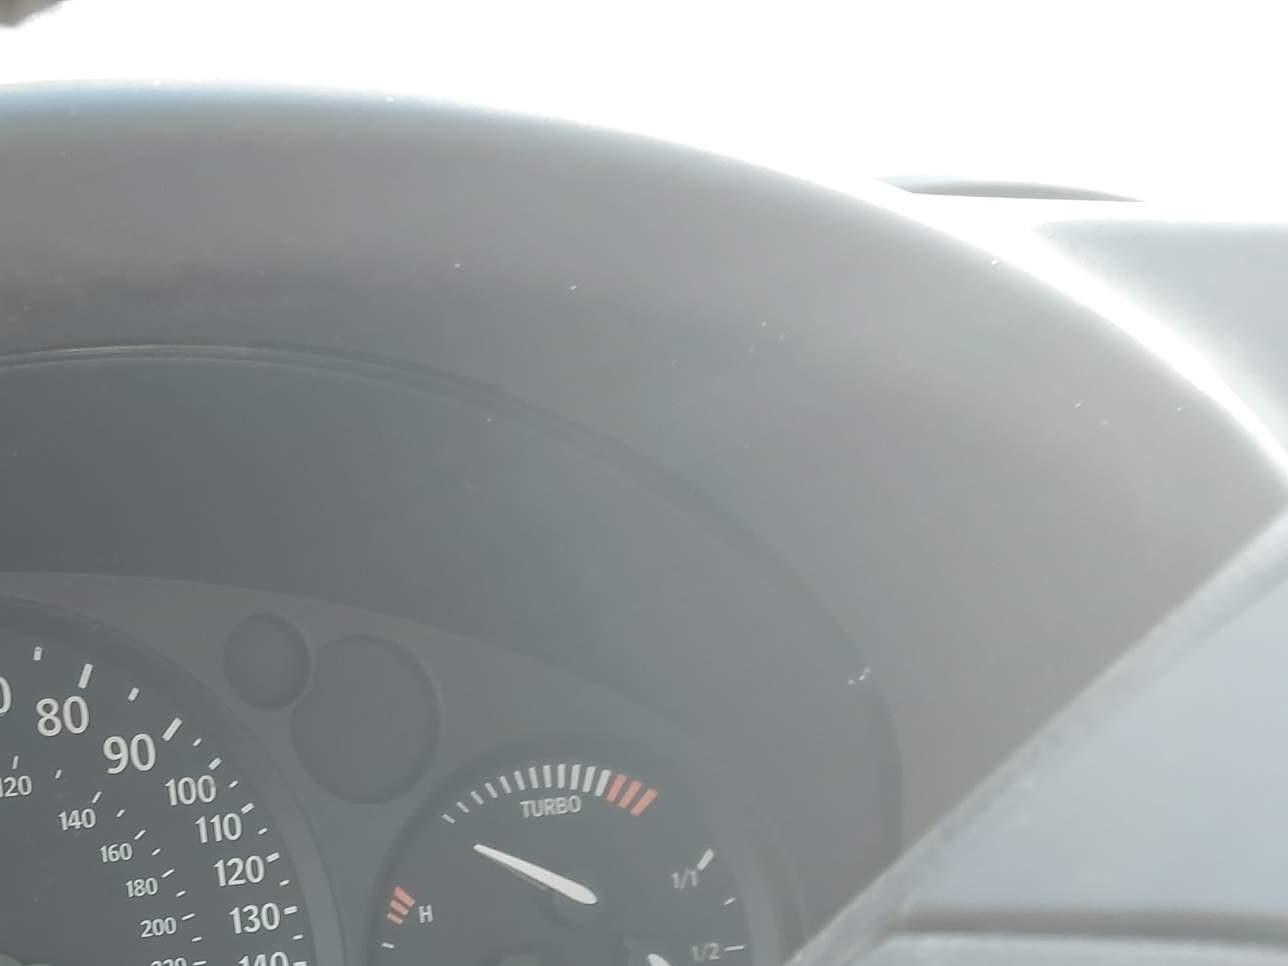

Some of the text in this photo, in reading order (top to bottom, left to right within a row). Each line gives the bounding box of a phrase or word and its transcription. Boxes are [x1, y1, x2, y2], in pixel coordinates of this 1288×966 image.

[36, 696, 89, 736] 80
[103, 733, 156, 774] 90
[164, 775, 216, 806] 100
[520, 796, 581, 818] TURBO
[58, 808, 96, 831] 140
[195, 813, 242, 844] 110
[100, 843, 132, 863] 160
[214, 855, 264, 886] 120
[672, 870, 698, 889] 1/1
[126, 877, 158, 898] 180
[229, 903, 280, 934] 130
[419, 905, 433, 923] H
[140, 917, 176, 938] 200
[692, 943, 720, 962] 1/2
